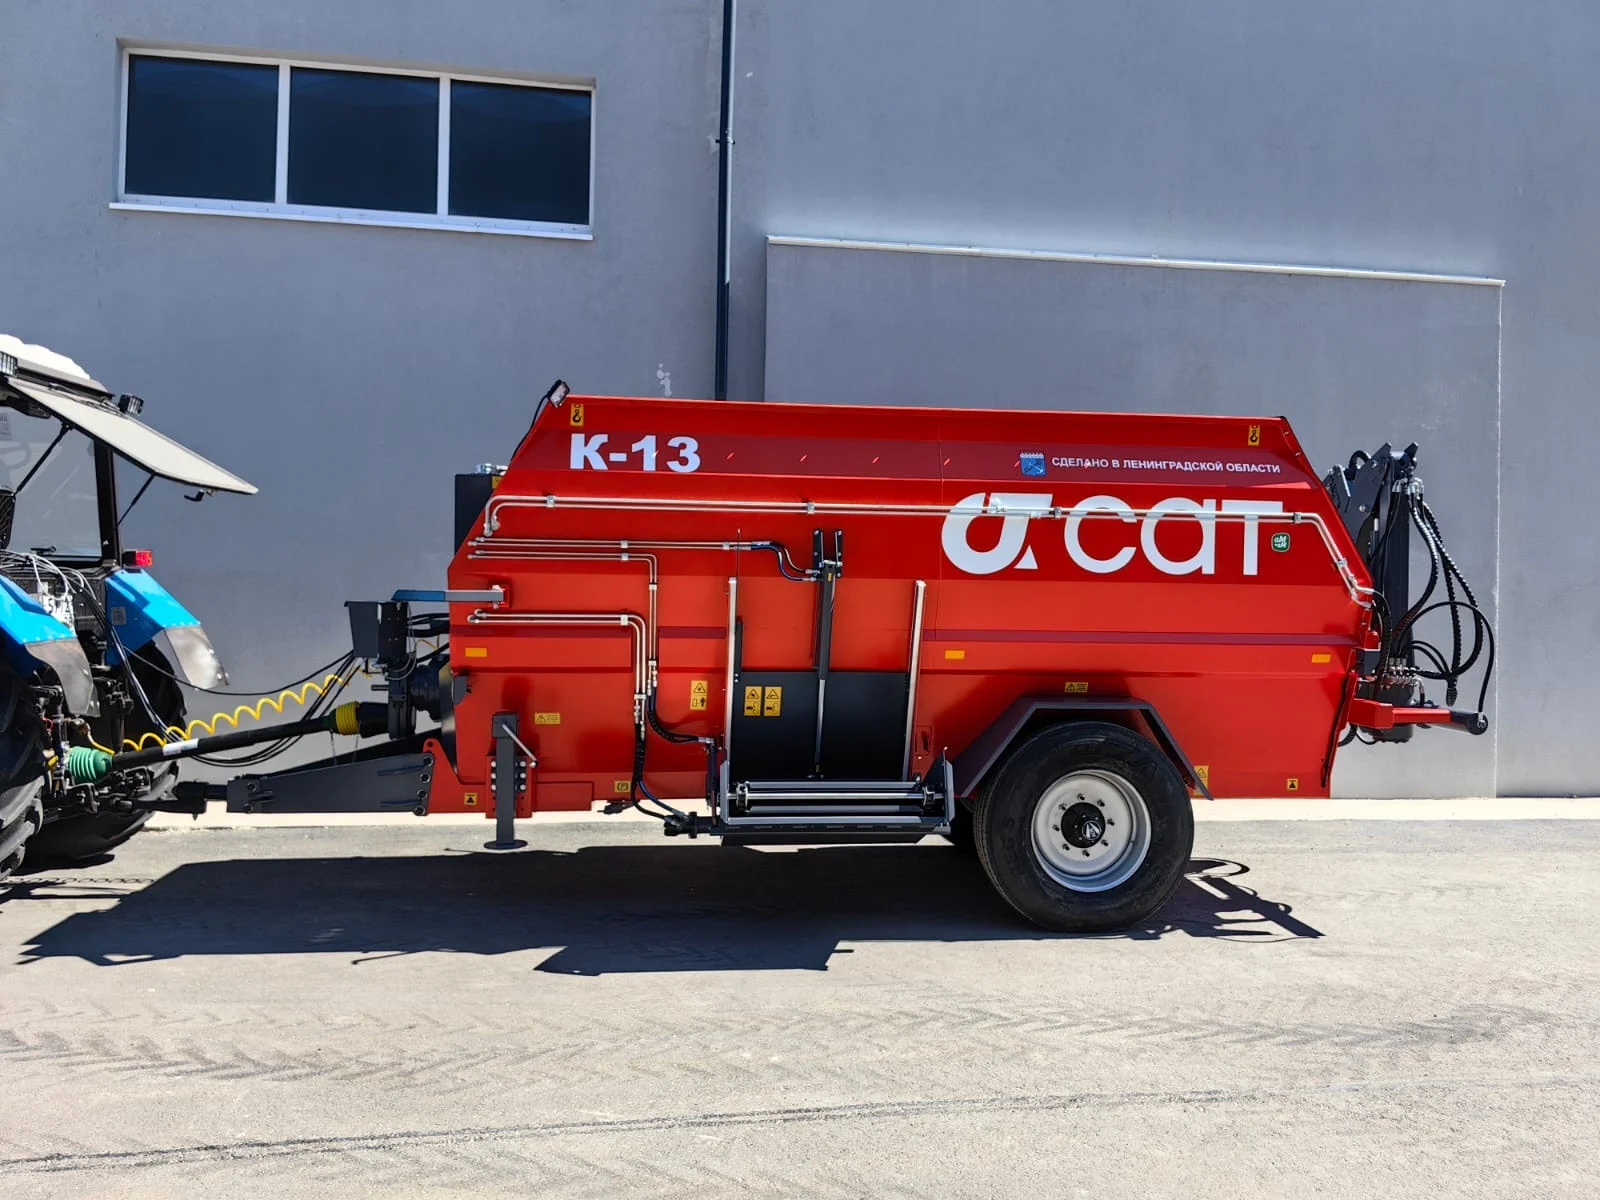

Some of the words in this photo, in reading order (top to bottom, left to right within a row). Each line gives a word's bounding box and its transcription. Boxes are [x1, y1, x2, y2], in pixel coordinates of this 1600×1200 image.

[1051, 456, 1108, 467] СДЕЛАНО
[1112, 459, 1121, 468] В
[1123, 460, 1222, 472] ЛЕНИНГРАДСКОЙ
[1225, 462, 1281, 473] ОБЛАСТИ
